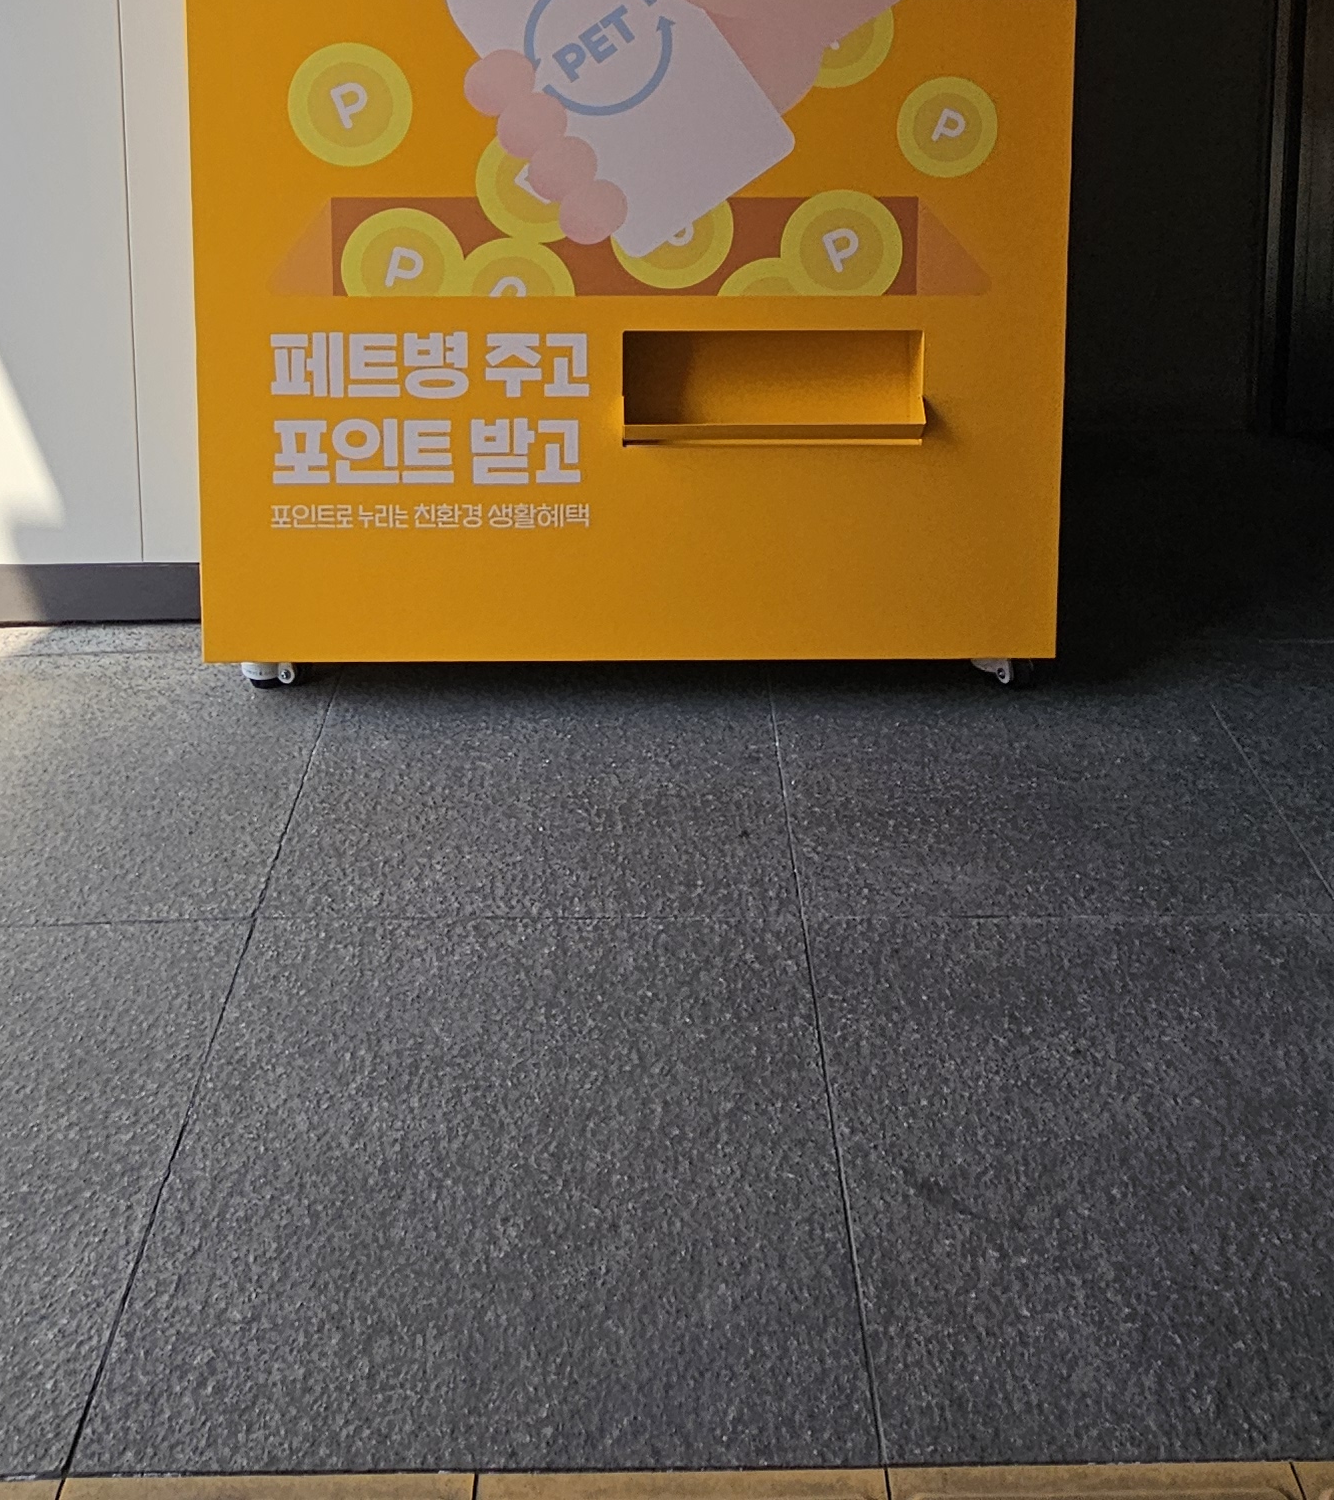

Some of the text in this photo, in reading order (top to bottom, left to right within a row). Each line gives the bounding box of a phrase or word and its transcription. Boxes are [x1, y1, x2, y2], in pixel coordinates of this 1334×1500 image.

[552, 5, 639, 84] PET
[329, 81, 368, 130] P
[930, 107, 966, 143] P
[384, 246, 424, 287] P
[821, 227, 860, 273] P
[270, 332, 590, 399] 페트병 주고
[272, 418, 581, 484] 포인트 받고
[270, 504, 590, 528] 포인트로 누리는 친환경 생활혜택
